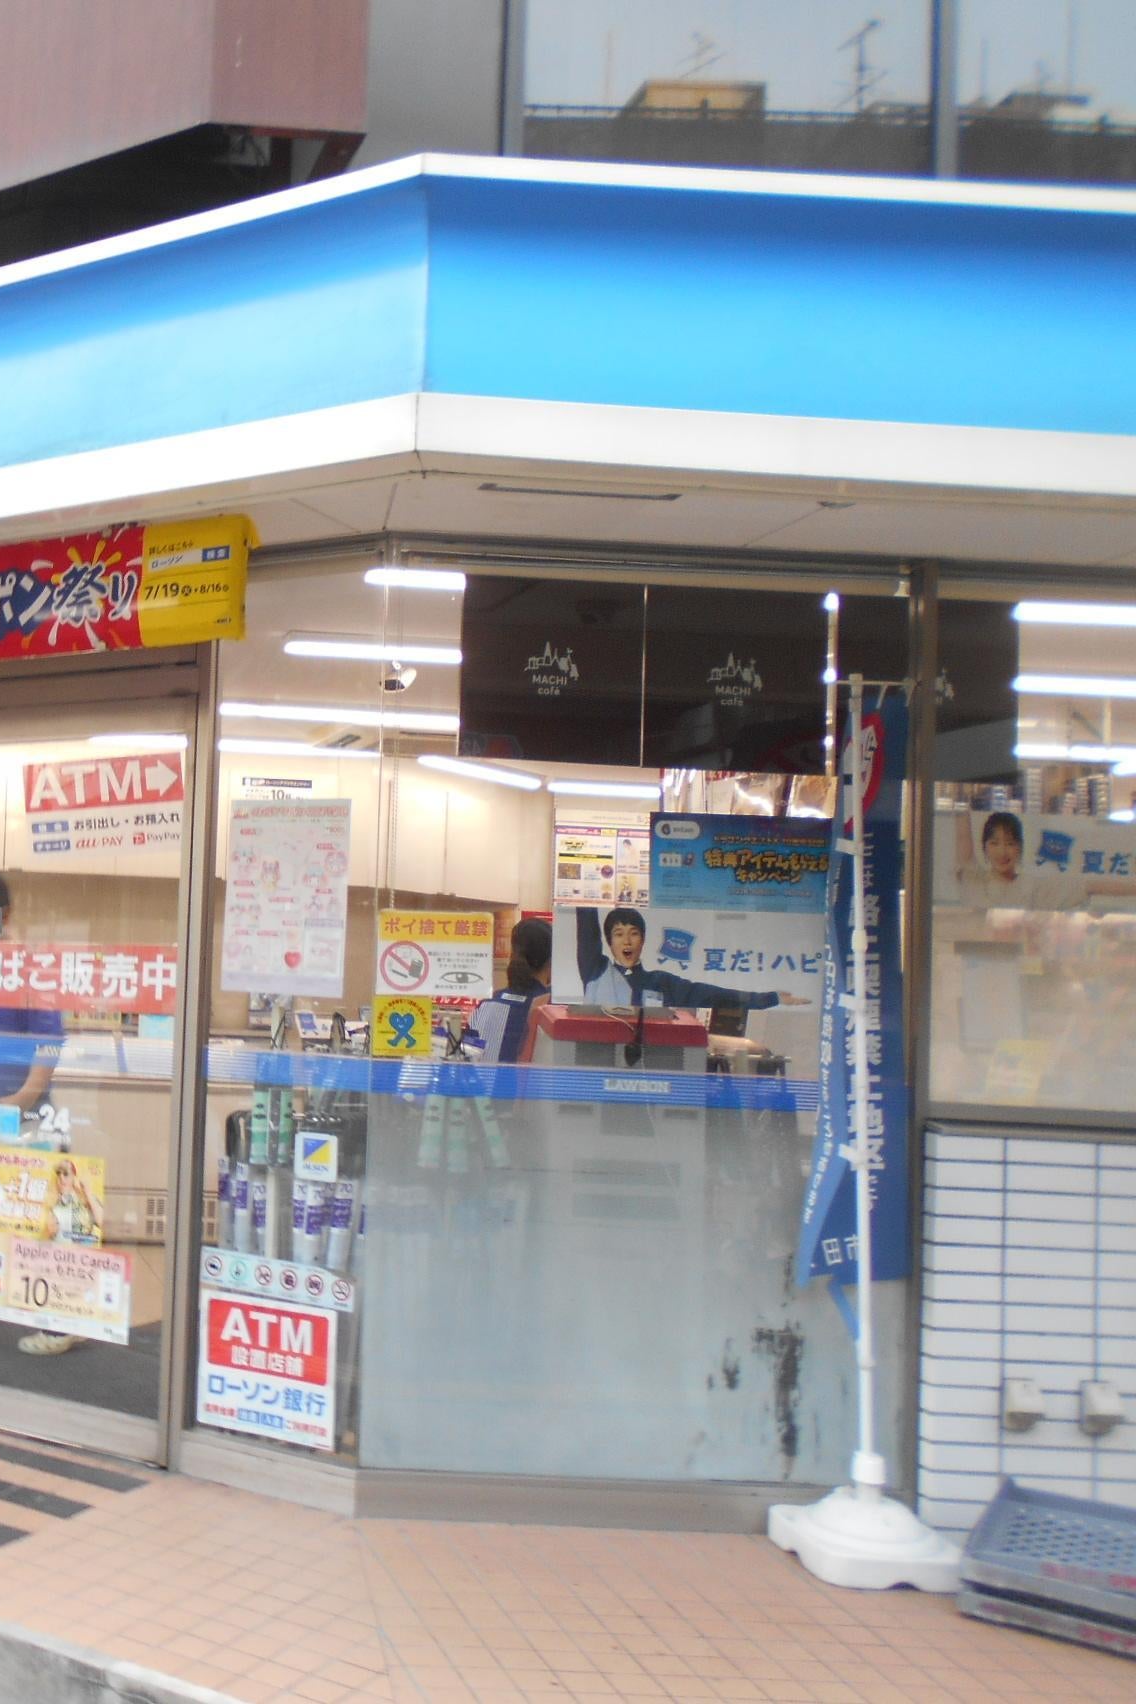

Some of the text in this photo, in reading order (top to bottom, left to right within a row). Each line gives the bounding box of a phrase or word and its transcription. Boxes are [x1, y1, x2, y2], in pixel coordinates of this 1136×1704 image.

[151, 556, 183, 569] ローソン
[145, 582, 179, 600] 7/19
[532, 674, 567, 686] MACHI
[715, 686, 752, 696] MACHI
[30, 760, 143, 808] ATM
[76, 837, 97, 849] au
[102, 836, 124, 847] PAY
[147, 832, 181, 842] PayPay
[384, 917, 490, 937] ポイ捨て厳禁
[603, 1078, 671, 1094] LAWSON
[39, 1103, 71, 1133] 24
[15, 1243, 49, 1259] Apple
[53, 1249, 76, 1263] Gift
[220, 1307, 314, 1356] ATM
[207, 1373, 327, 1417] ローソン銀行
